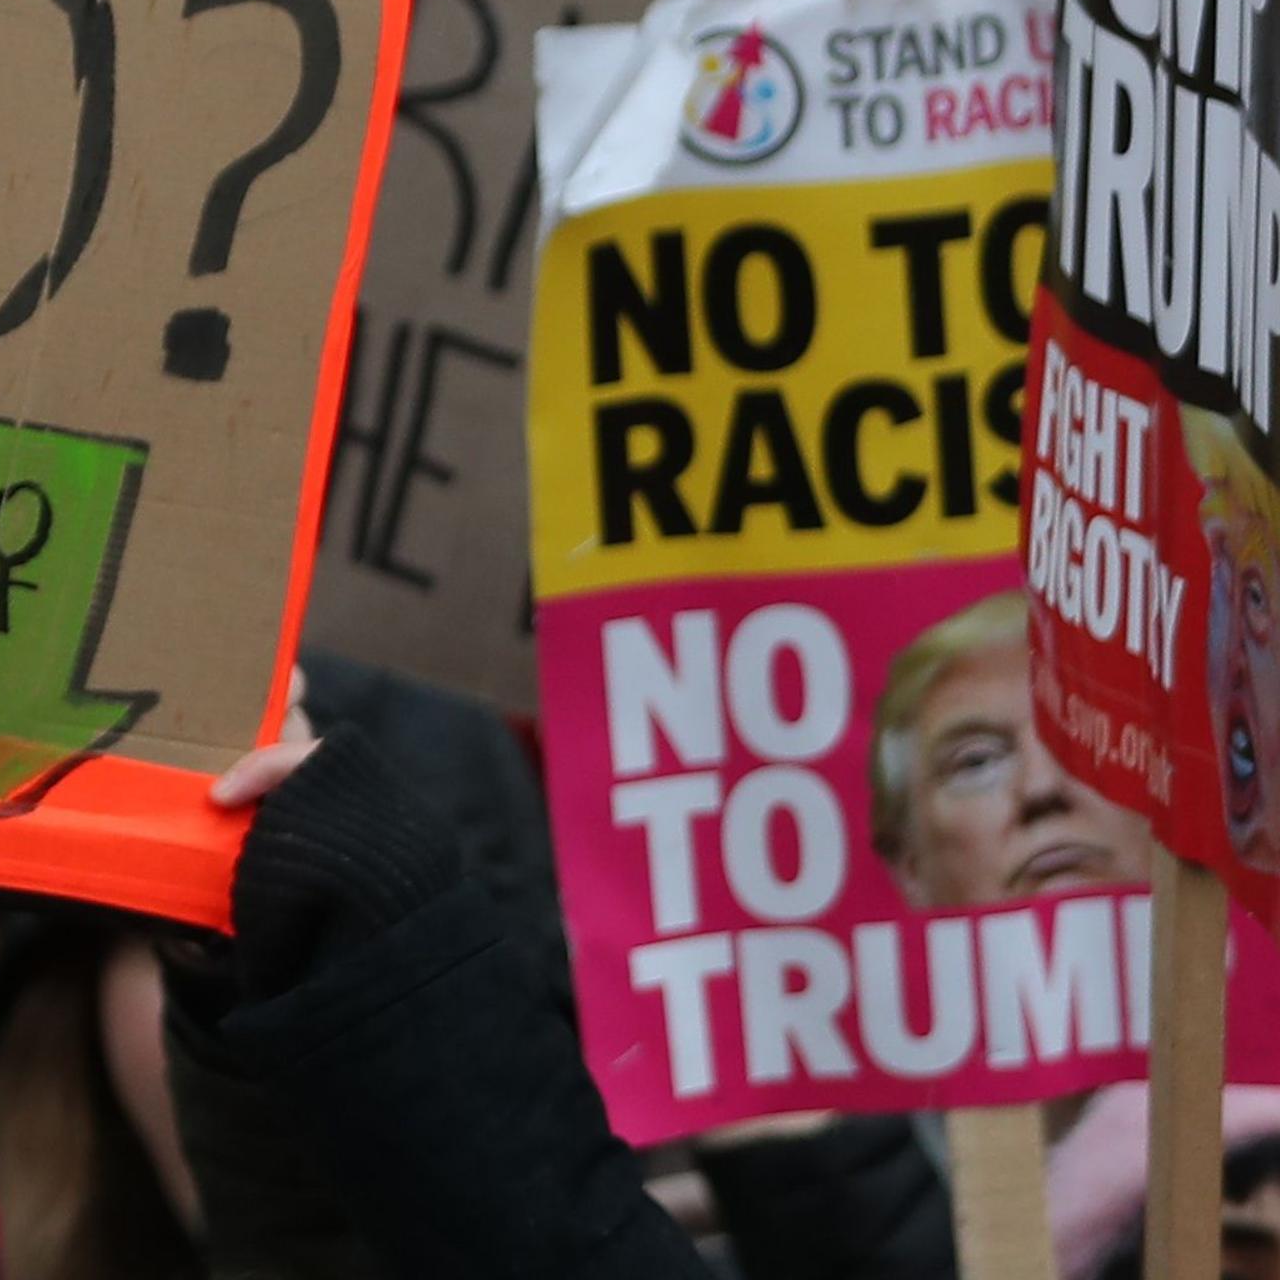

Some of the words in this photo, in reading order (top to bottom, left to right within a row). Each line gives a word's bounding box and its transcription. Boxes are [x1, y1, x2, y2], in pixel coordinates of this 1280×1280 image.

[827, 14, 1007, 85] STAND
[828, 92, 905, 150] TO
[924, 73, 1056, 142] RACI
[586, 221, 819, 386] NO
[592, 357, 1026, 548] RACIS
[1036, 337, 1150, 522] FIGHT
[1028, 467, 1186, 693] BIGOTRY
[600, 602, 854, 777] NO
[610, 765, 848, 937] TO
